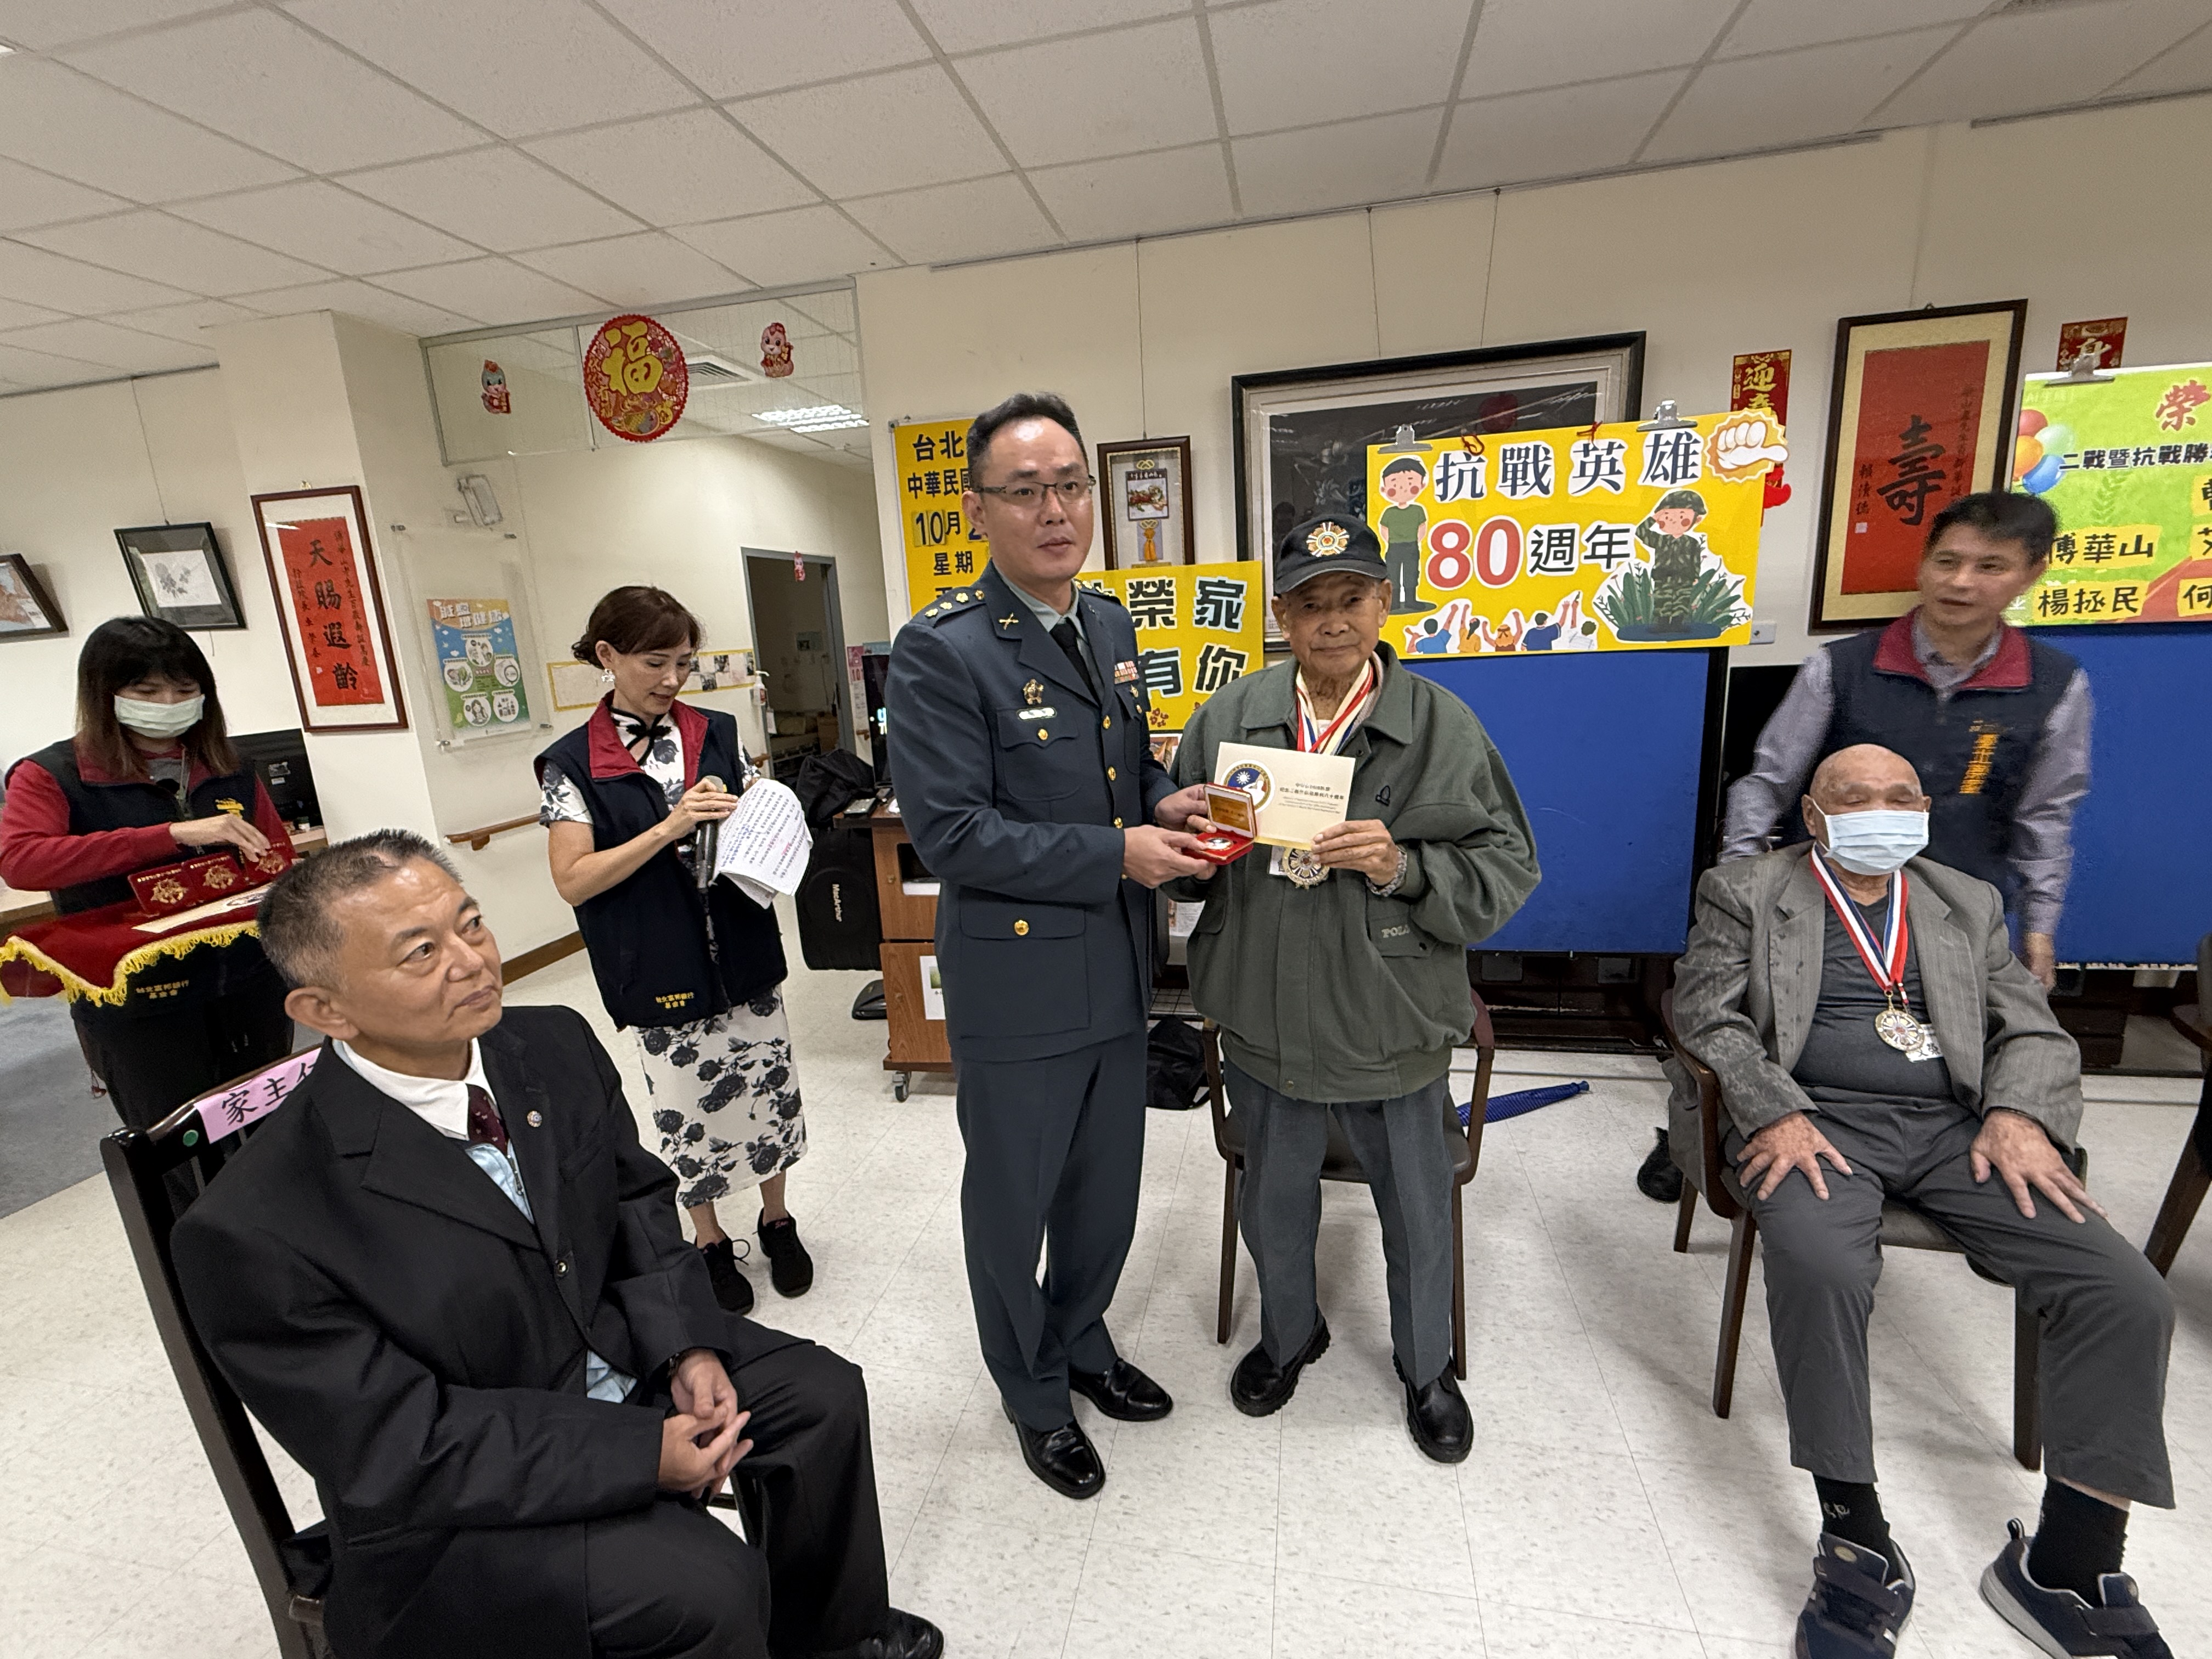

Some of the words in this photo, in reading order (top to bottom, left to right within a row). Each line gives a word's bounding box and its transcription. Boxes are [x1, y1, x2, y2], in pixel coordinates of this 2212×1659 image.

[601, 320, 663, 396] 福
[2156, 380, 2211, 431] 榮
[912, 430, 964, 462] 台北
[2059, 442, 2212, 470] 二戰暨抗戰勝
[1435, 431, 1701, 502] 抗戰英雄
[1877, 414, 1946, 525] 壽
[934, 551, 974, 576] 星期
[2038, 587, 2139, 618] 楊拯民
[832, 884, 843, 922] MacArthur
